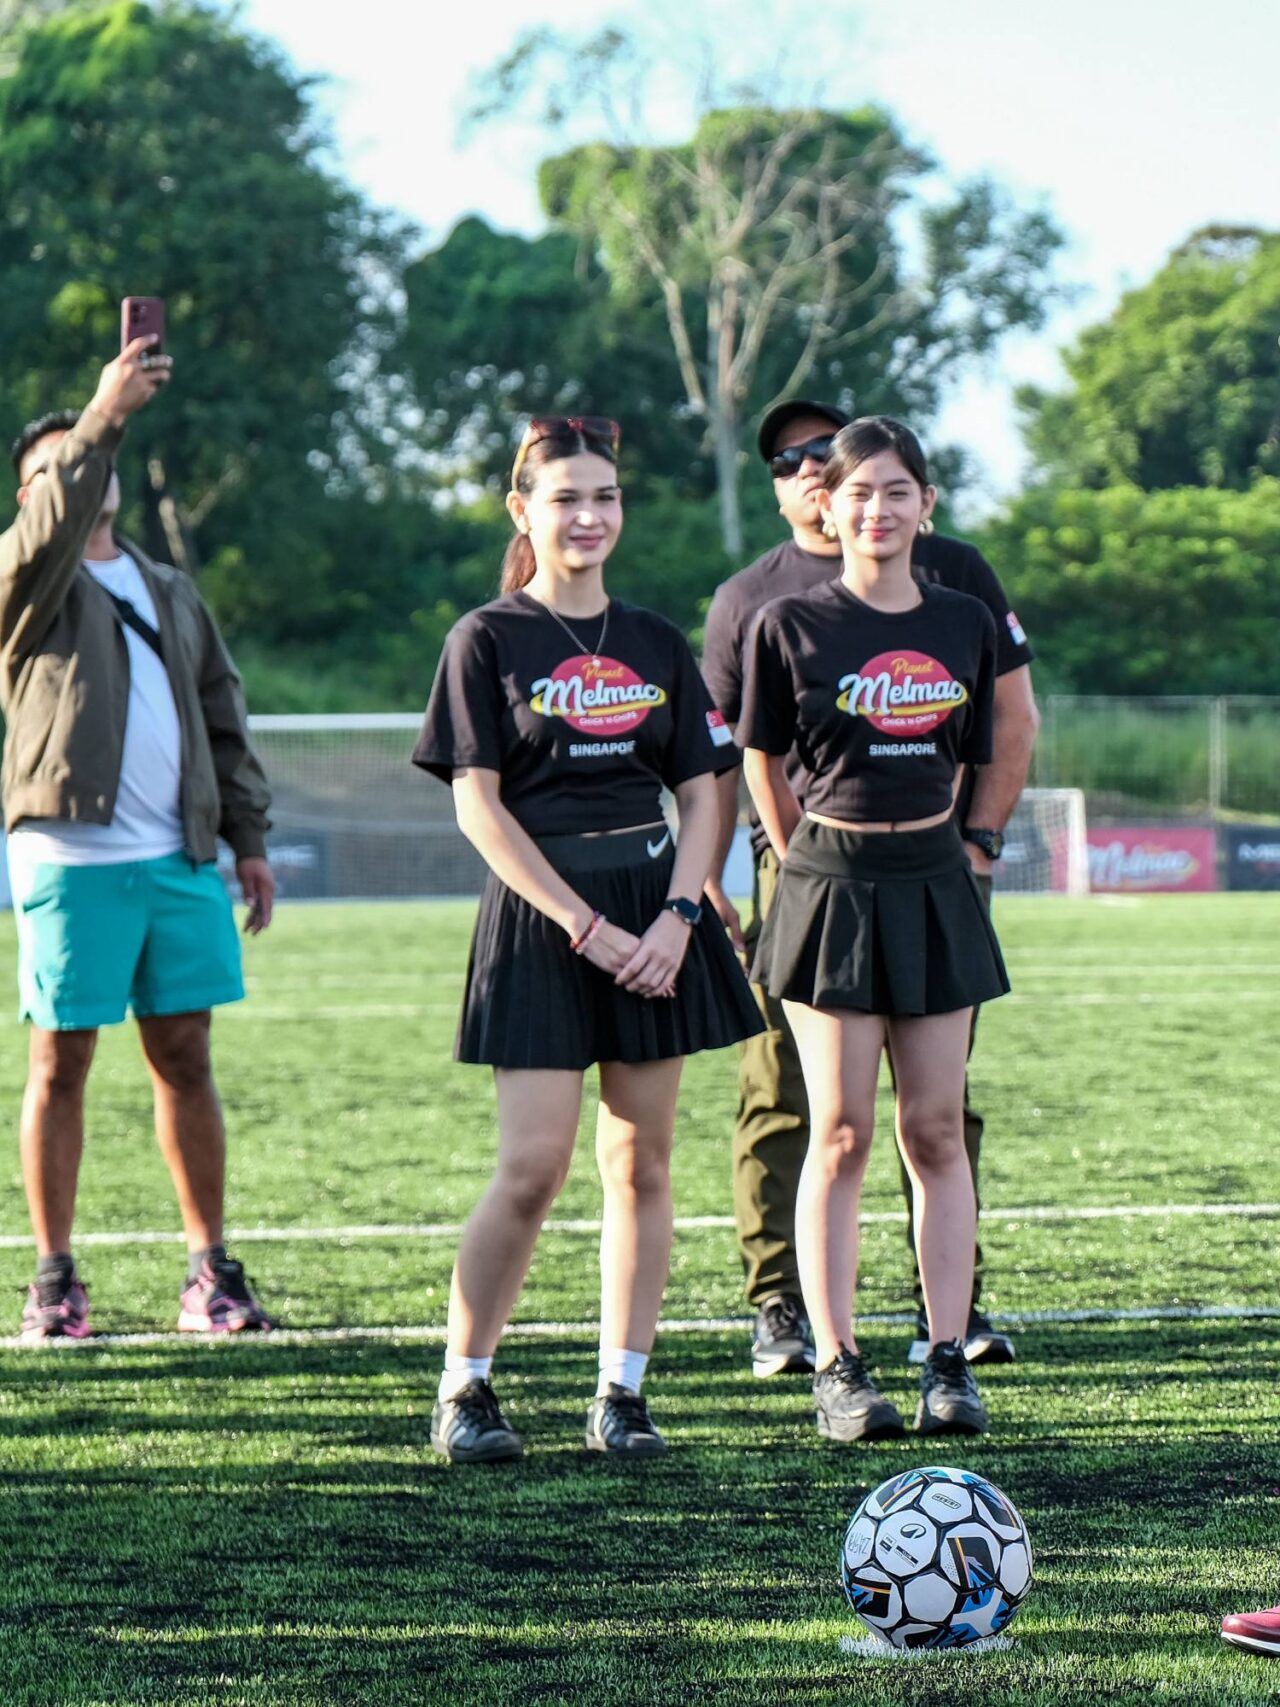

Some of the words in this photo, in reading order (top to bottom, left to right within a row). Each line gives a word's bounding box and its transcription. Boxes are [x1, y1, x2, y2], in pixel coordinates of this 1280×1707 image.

[531, 675, 661, 717] Melmac
[838, 672, 964, 716] Melmac
[868, 742, 936, 757] SINGAPORE
